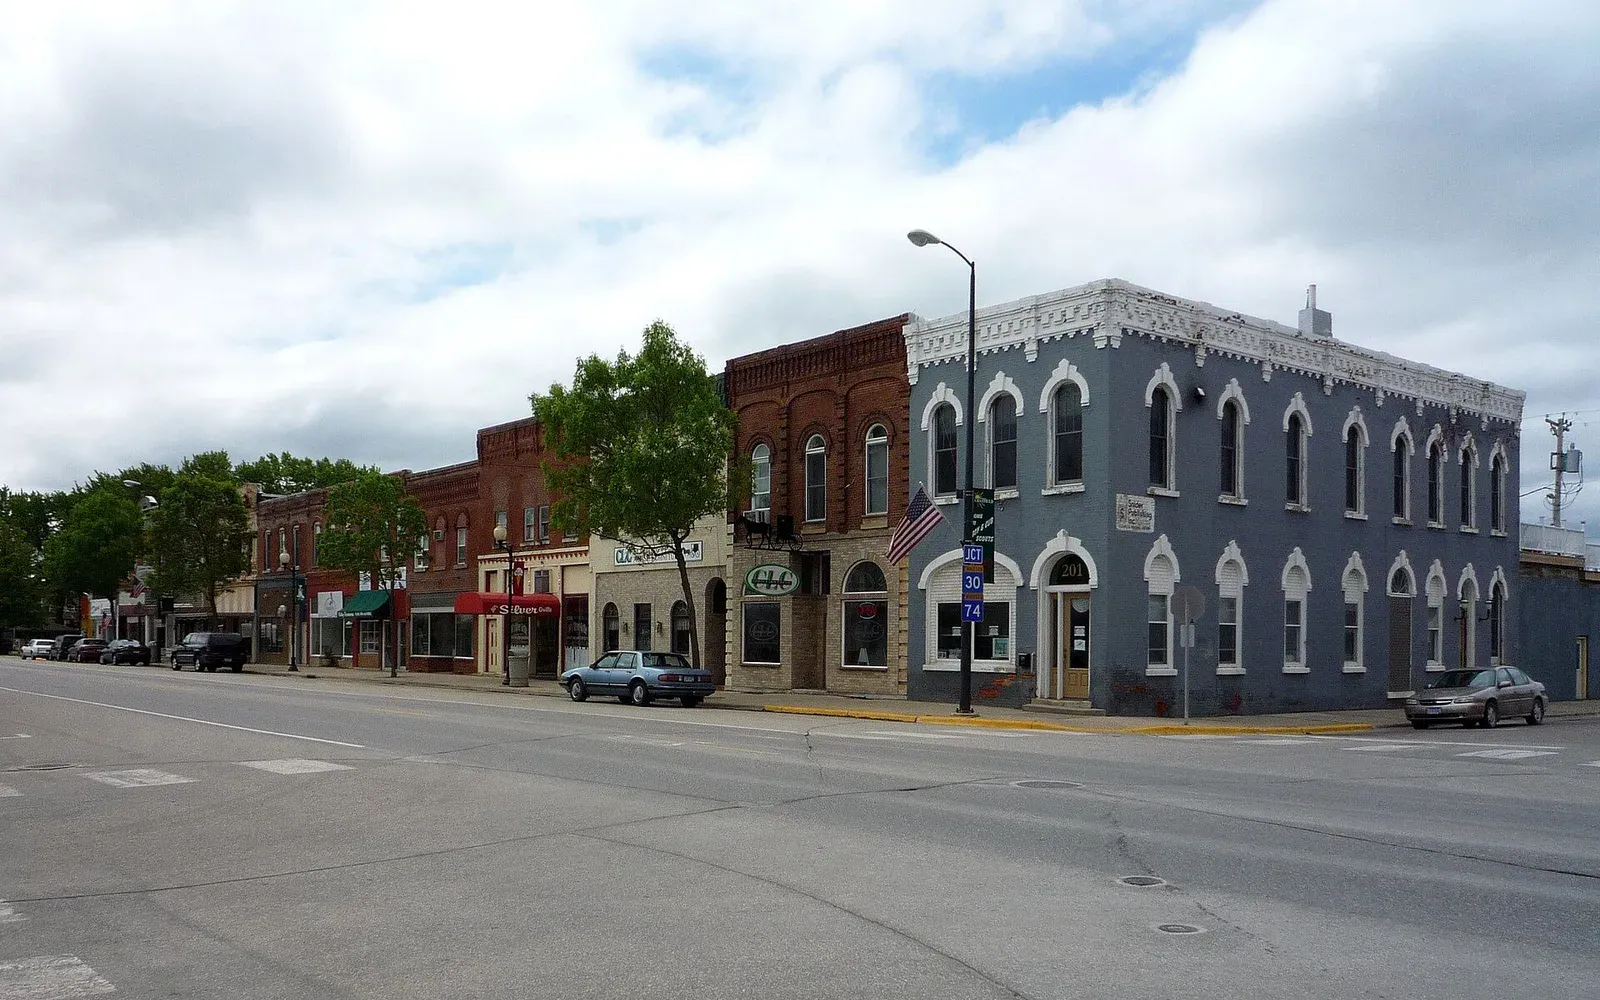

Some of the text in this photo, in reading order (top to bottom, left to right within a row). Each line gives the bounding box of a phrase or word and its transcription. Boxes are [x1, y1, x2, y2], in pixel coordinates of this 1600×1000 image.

[965, 549, 981, 560] JCT
[1061, 563, 1082, 577] 201
[965, 576, 980, 589] 30
[499, 604, 538, 615] Silver
[965, 604, 980, 617] 74
